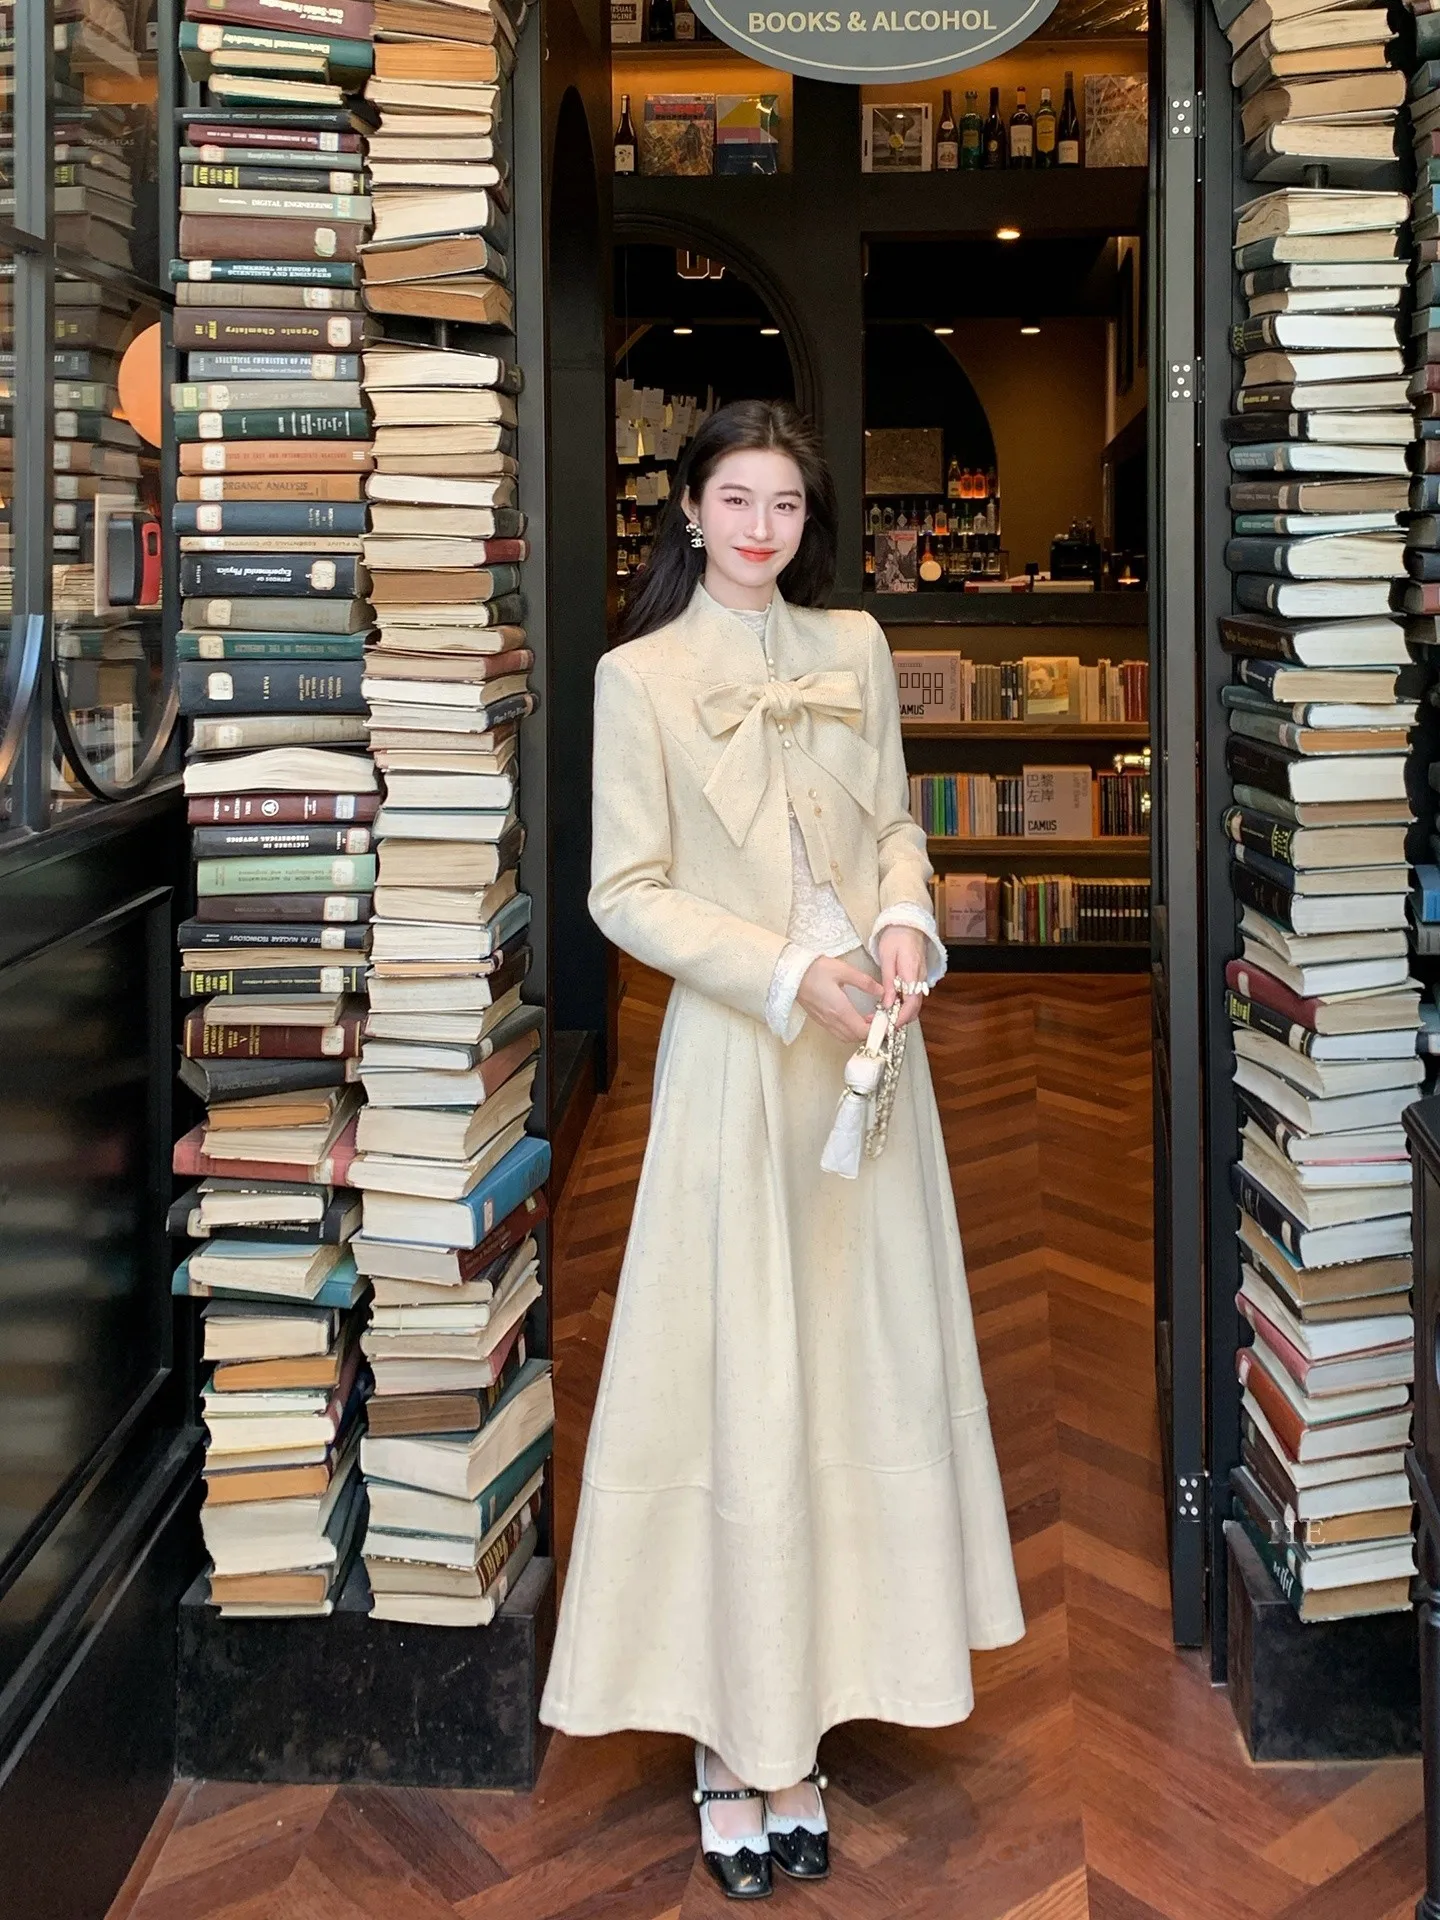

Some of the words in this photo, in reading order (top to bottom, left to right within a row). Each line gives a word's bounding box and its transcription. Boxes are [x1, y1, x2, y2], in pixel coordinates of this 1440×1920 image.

[748, 12, 841, 33] BOOKS
[847, 11, 867, 32] &
[872, 10, 997, 31] ALCOHOL
[284, 201, 333, 210] ENGINEERING
[225, 326, 275, 335] Chemistry
[281, 328, 319, 336] Organic
[266, 482, 308, 490] ANALYSIS
[216, 566, 243, 576] Physics
[243, 568, 292, 577] Experimental
[1027, 774, 1054, 788] 巴黎
[1027, 789, 1054, 803] 左岸
[1028, 820, 1057, 831] CAMUS
[196, 975, 204, 993] ASTM
